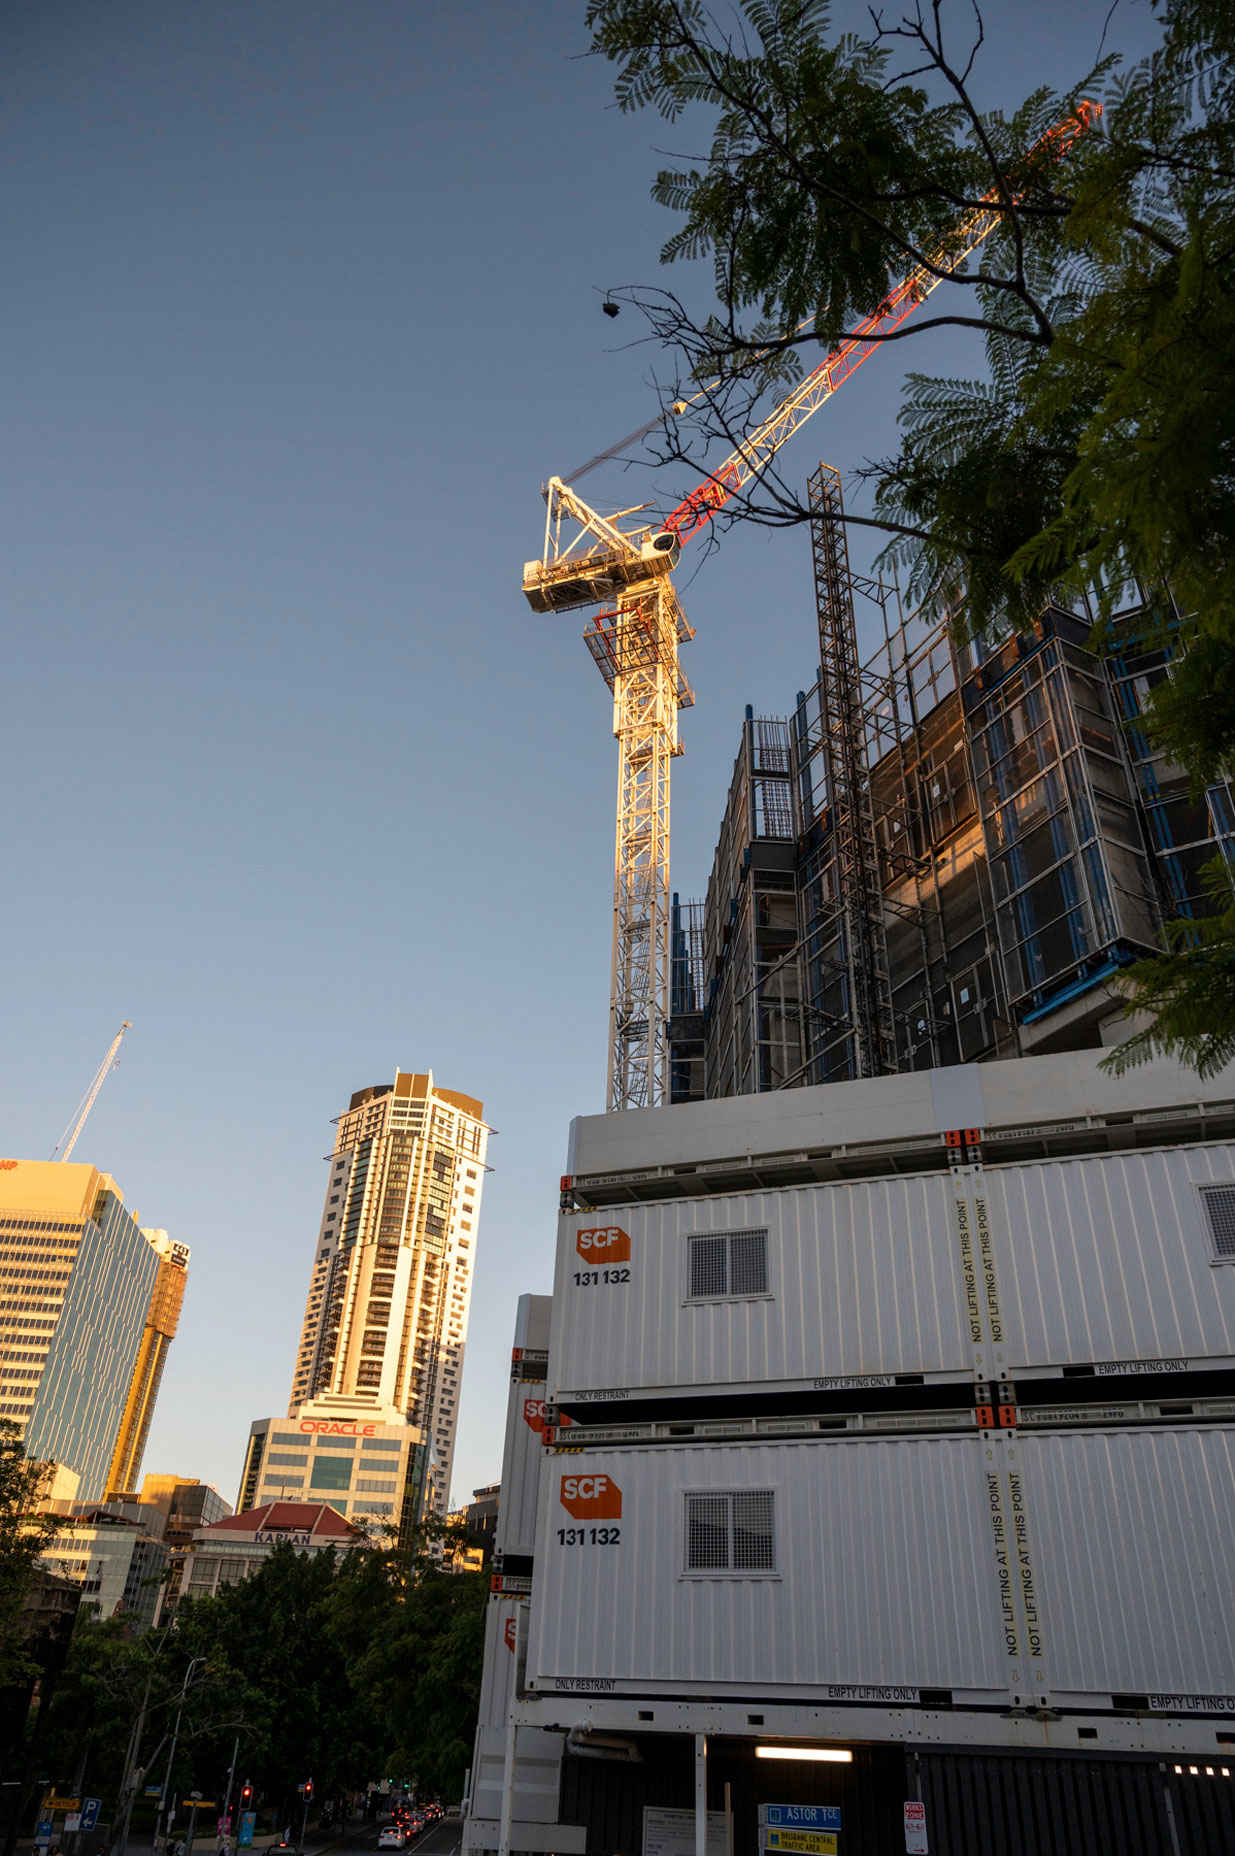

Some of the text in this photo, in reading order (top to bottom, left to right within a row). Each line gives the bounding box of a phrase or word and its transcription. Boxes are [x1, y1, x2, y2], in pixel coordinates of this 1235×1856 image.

[580, 1229, 619, 1249] SCF
[957, 1200, 981, 1342] NOT LIFTING AT THIS POINT
[976, 1199, 1002, 1342] NOT LIFTING AT THIS POINT
[1099, 1360, 1189, 1374] EMPTY LIFTING ONLY
[814, 1377, 892, 1389] EMPTY LIFTING ONLY
[575, 1390, 629, 1400] ONLY RESTRAINT
[300, 1421, 376, 1436] ORACLE
[564, 1478, 606, 1499] SCF
[254, 1532, 310, 1545] KAPLAN
[988, 1474, 1018, 1656] NOT LIFTING AT THIS POINT
[1010, 1472, 1042, 1656] NOT LIFTING AT THIS POINT
[556, 1680, 616, 1690] ONLY RESTRAINT
[828, 1687, 917, 1700] EMPTY LIFTING ONLY
[1150, 1696, 1182, 1708] EMPTY
[1186, 1697, 1224, 1710] LIFTING
[86, 1801, 96, 1814] P
[787, 1808, 817, 1821] ASTOR
[906, 1812, 924, 1820] ZONE
[781, 1832, 834, 1844] BRISBANE CENTRAL
[781, 1840, 820, 1852] TRAFFIC AREA
